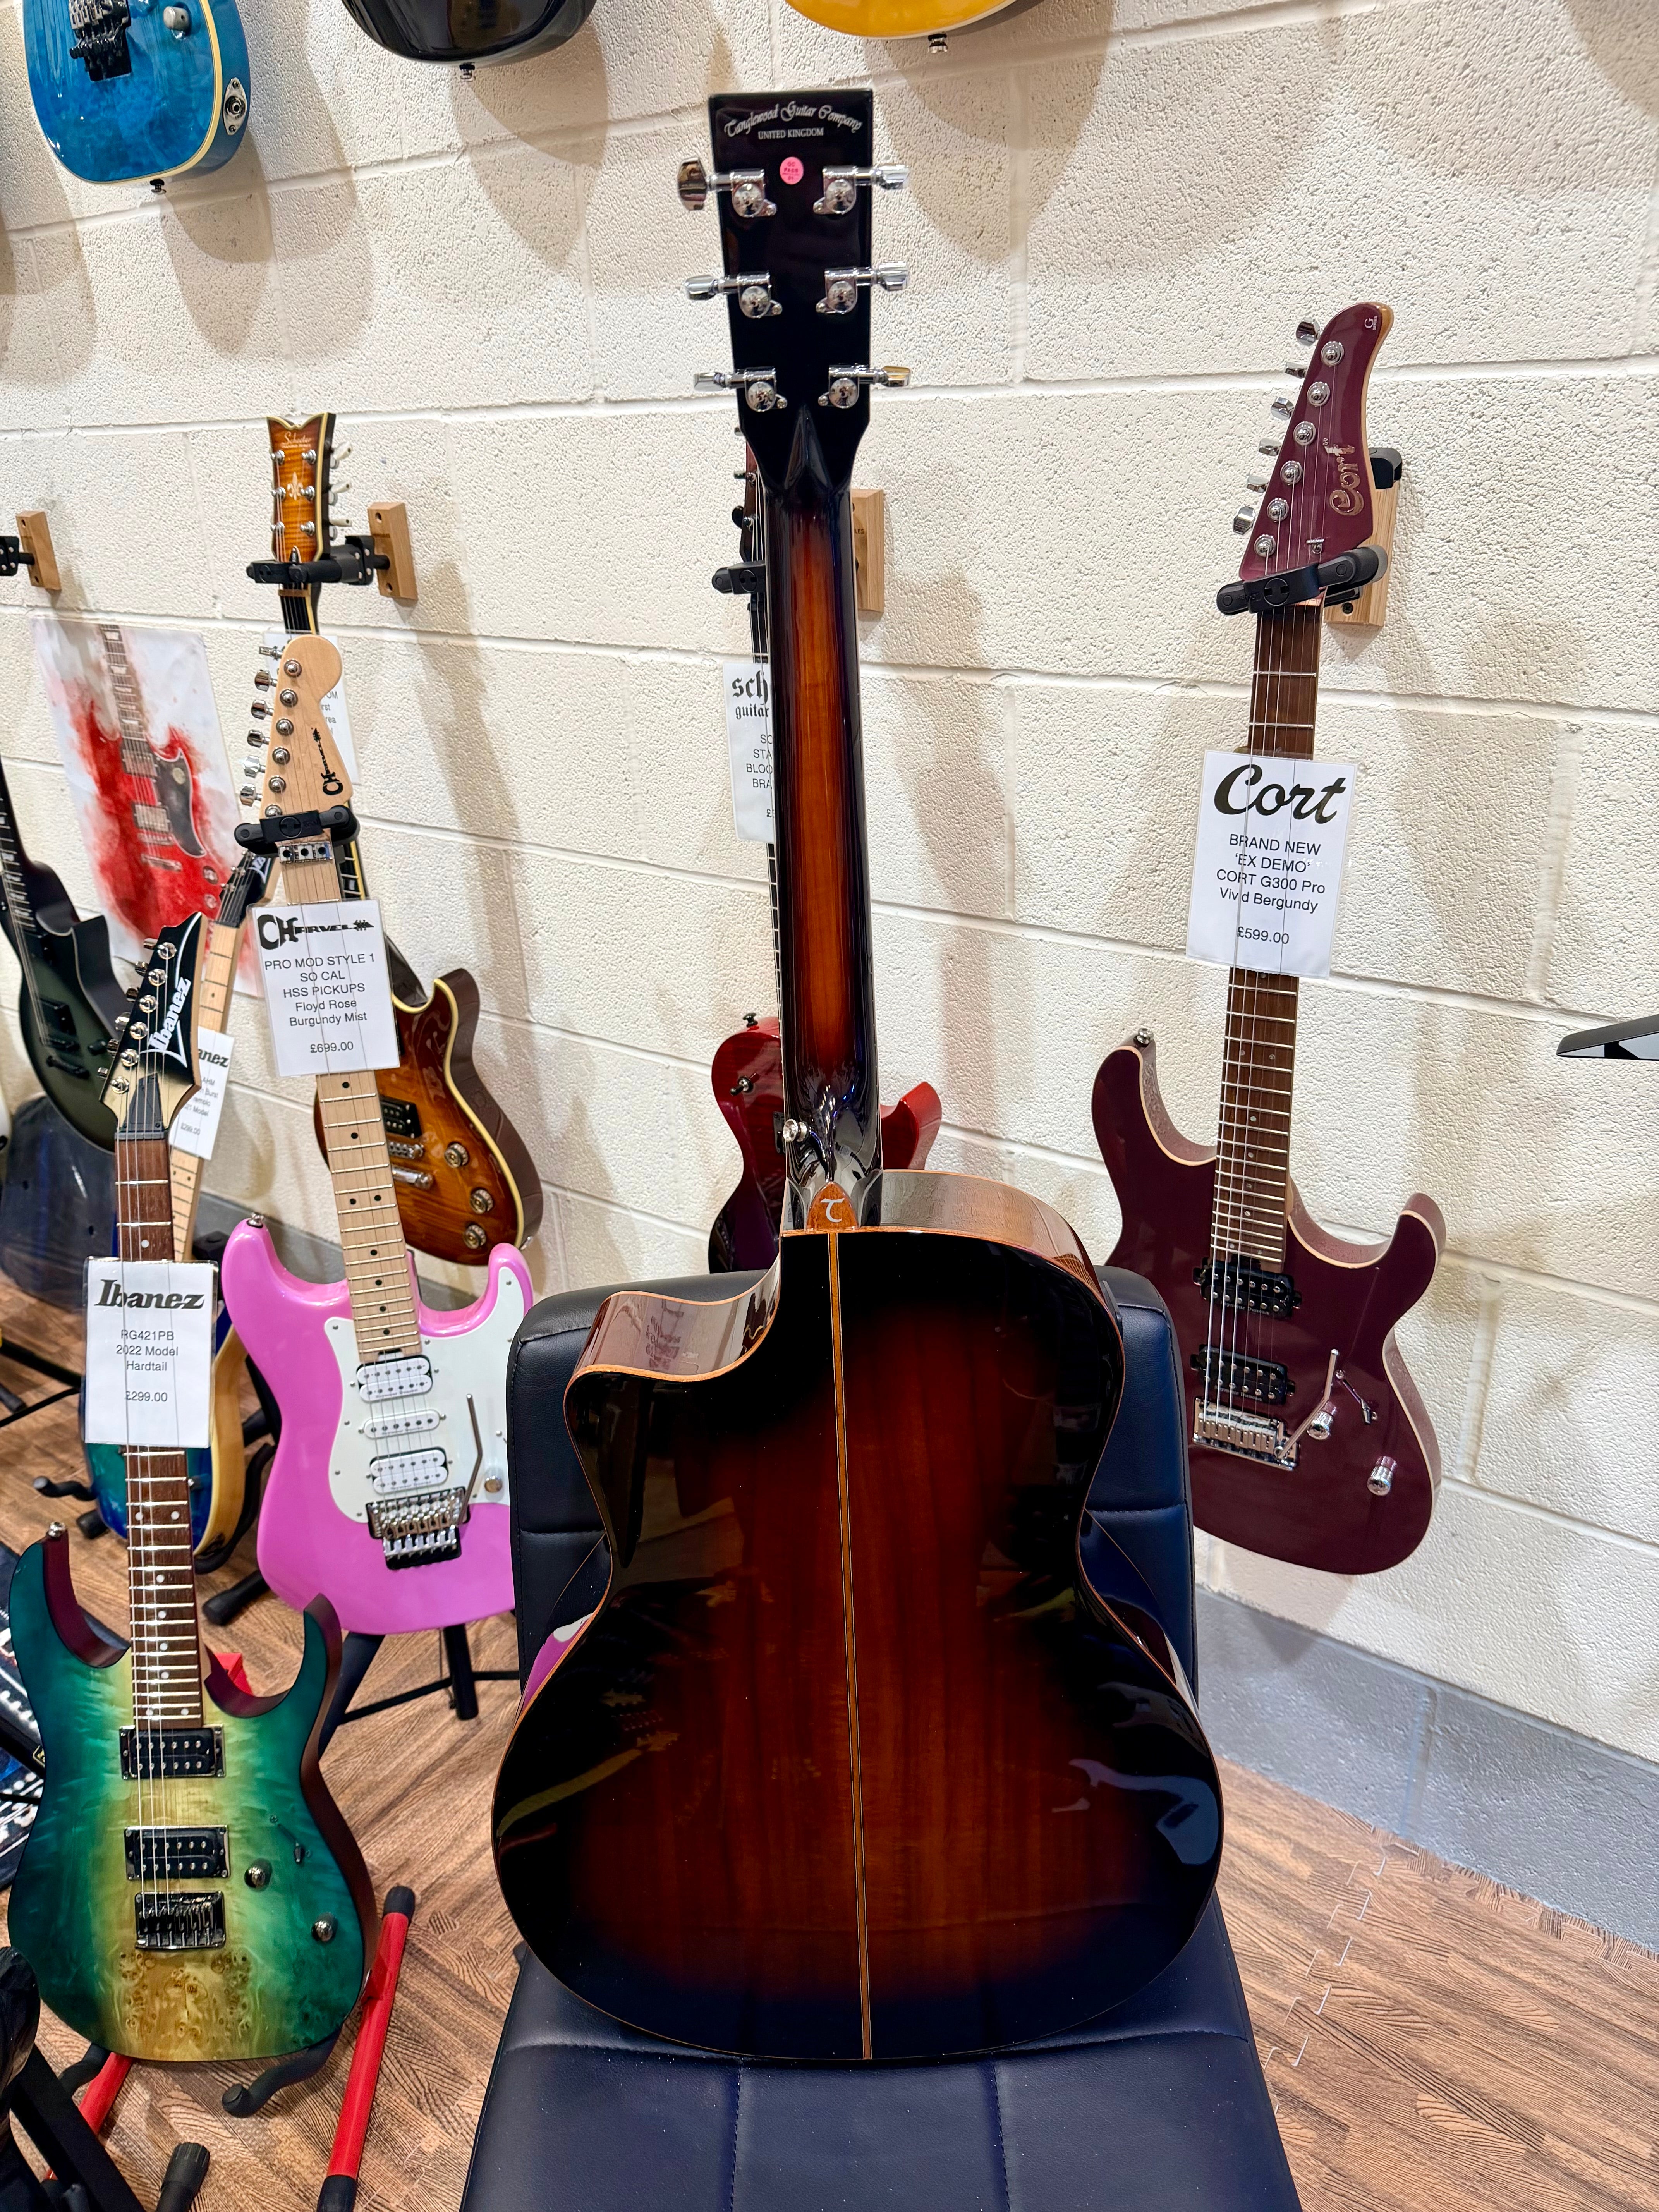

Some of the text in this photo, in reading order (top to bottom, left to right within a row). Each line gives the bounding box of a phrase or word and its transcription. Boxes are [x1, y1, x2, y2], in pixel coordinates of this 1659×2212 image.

[724, 101, 862, 137] Tanglewood Guitar Company
[758, 127, 824, 140] UNITED KINGDOM
[1364, 318, 1374, 328] G
[1324, 444, 1364, 516] Cort
[732, 670, 768, 704] sch
[760, 734, 772, 744] SC
[753, 749, 772, 759] STA
[746, 763, 773, 774] BLOO
[752, 778, 774, 789] BRA
[1214, 764, 1346, 824] Cort
[1230, 834, 1321, 855] BRAND NEW
[1216, 870, 1325, 893] CORT G300 Pro
[1220, 887, 1317, 913] Vivd Bergundy
[1237, 926, 1289, 944] £599.00
[265, 953, 374, 970] PRO MOD STYLE 1
[300, 970, 345, 982] SO CAL
[283, 983, 366, 998] HSS PICKUPS
[295, 999, 357, 1012] Floyd Rose
[148, 977, 191, 1051] Ibanez
[290, 1012, 367, 1027] Burgundy Mist
[310, 1041, 354, 1053] £699.00
[198, 1048, 229, 1067] anez
[94, 1279, 204, 1309] Ibanez
[121, 1329, 174, 1341] RG421PB
[116, 1345, 178, 1356] 2022 Model
[126, 1360, 167, 1371] Hardtail
[125, 1391, 168, 1402] £299.00
